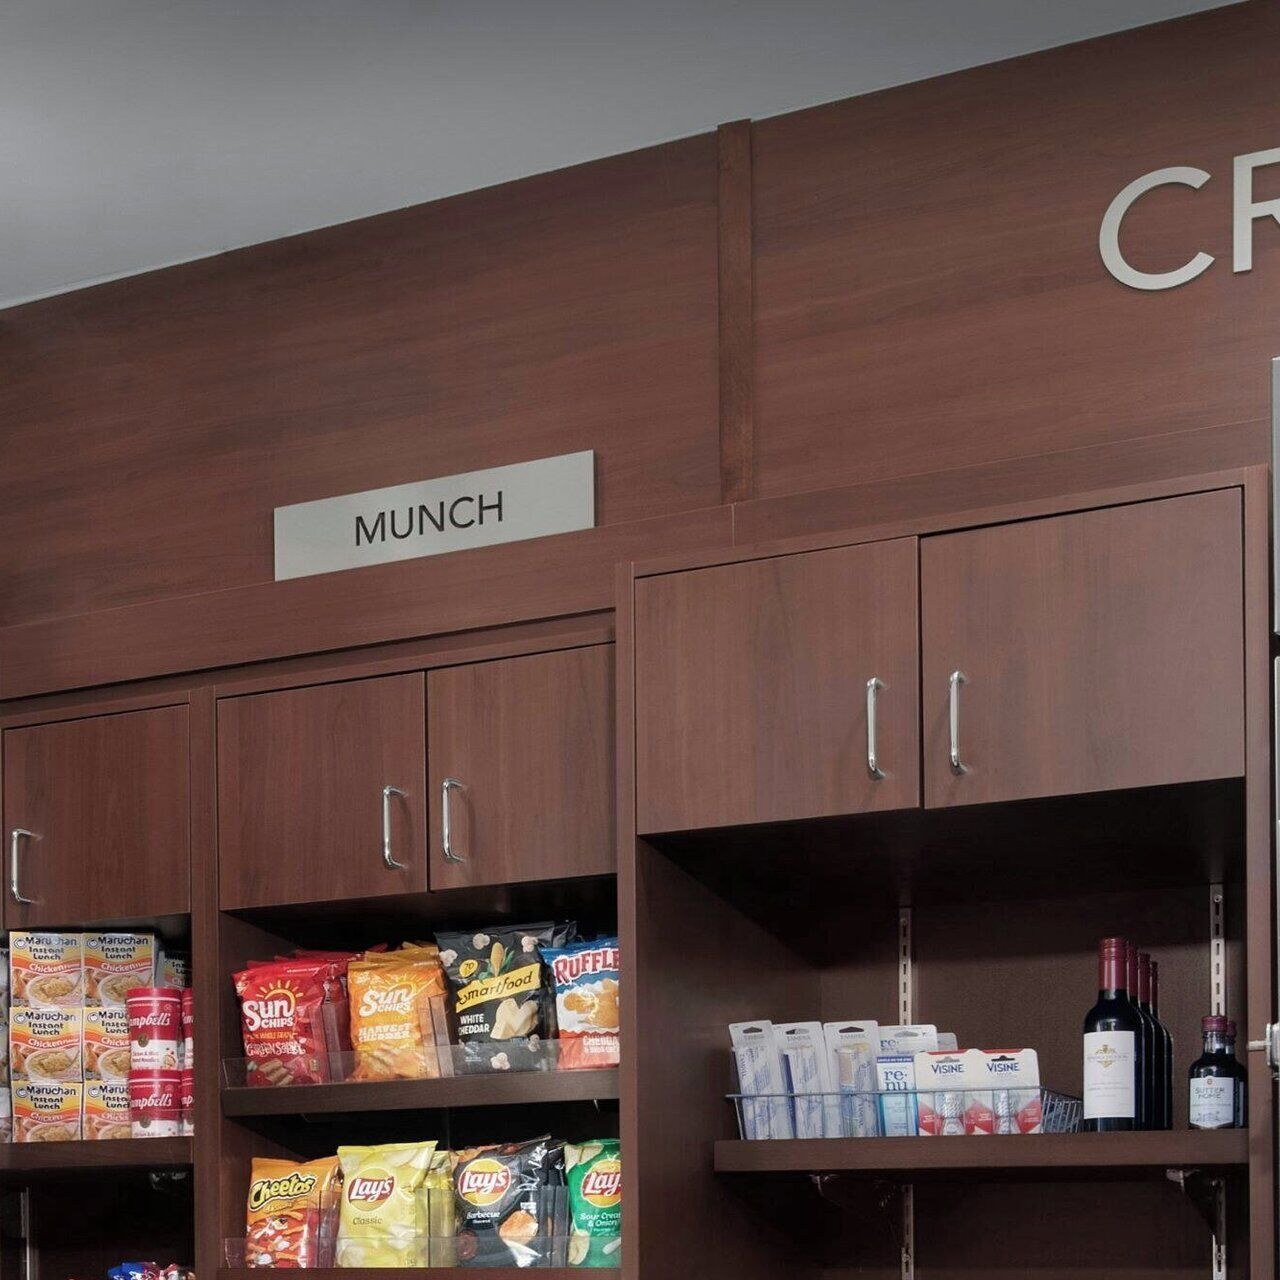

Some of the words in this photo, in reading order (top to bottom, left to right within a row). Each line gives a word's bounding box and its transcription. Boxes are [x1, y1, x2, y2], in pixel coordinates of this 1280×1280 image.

[356, 491, 503, 546] MUNCH
[359, 987, 409, 1017] Sun
[25, 1012, 76, 1021] Maruchan
[243, 999, 293, 1031] Sun
[460, 1014, 484, 1025] WHITE
[262, 1018, 293, 1028] CHIPS
[458, 1023, 490, 1035] CHEDDAR
[28, 1039, 62, 1048] Chicken
[931, 1064, 965, 1074] VISINE
[986, 1062, 1019, 1073] VISINE
[27, 1087, 76, 1096] Maruchan
[461, 1168, 509, 1195] Lay's
[251, 1173, 315, 1211] Cheetos
[349, 1177, 394, 1201] Lay's
[466, 1210, 500, 1219] Barbecue
[581, 1212, 597, 1221] Sour
[353, 1216, 383, 1225] Classic
[596, 1219, 619, 1227] Onion
